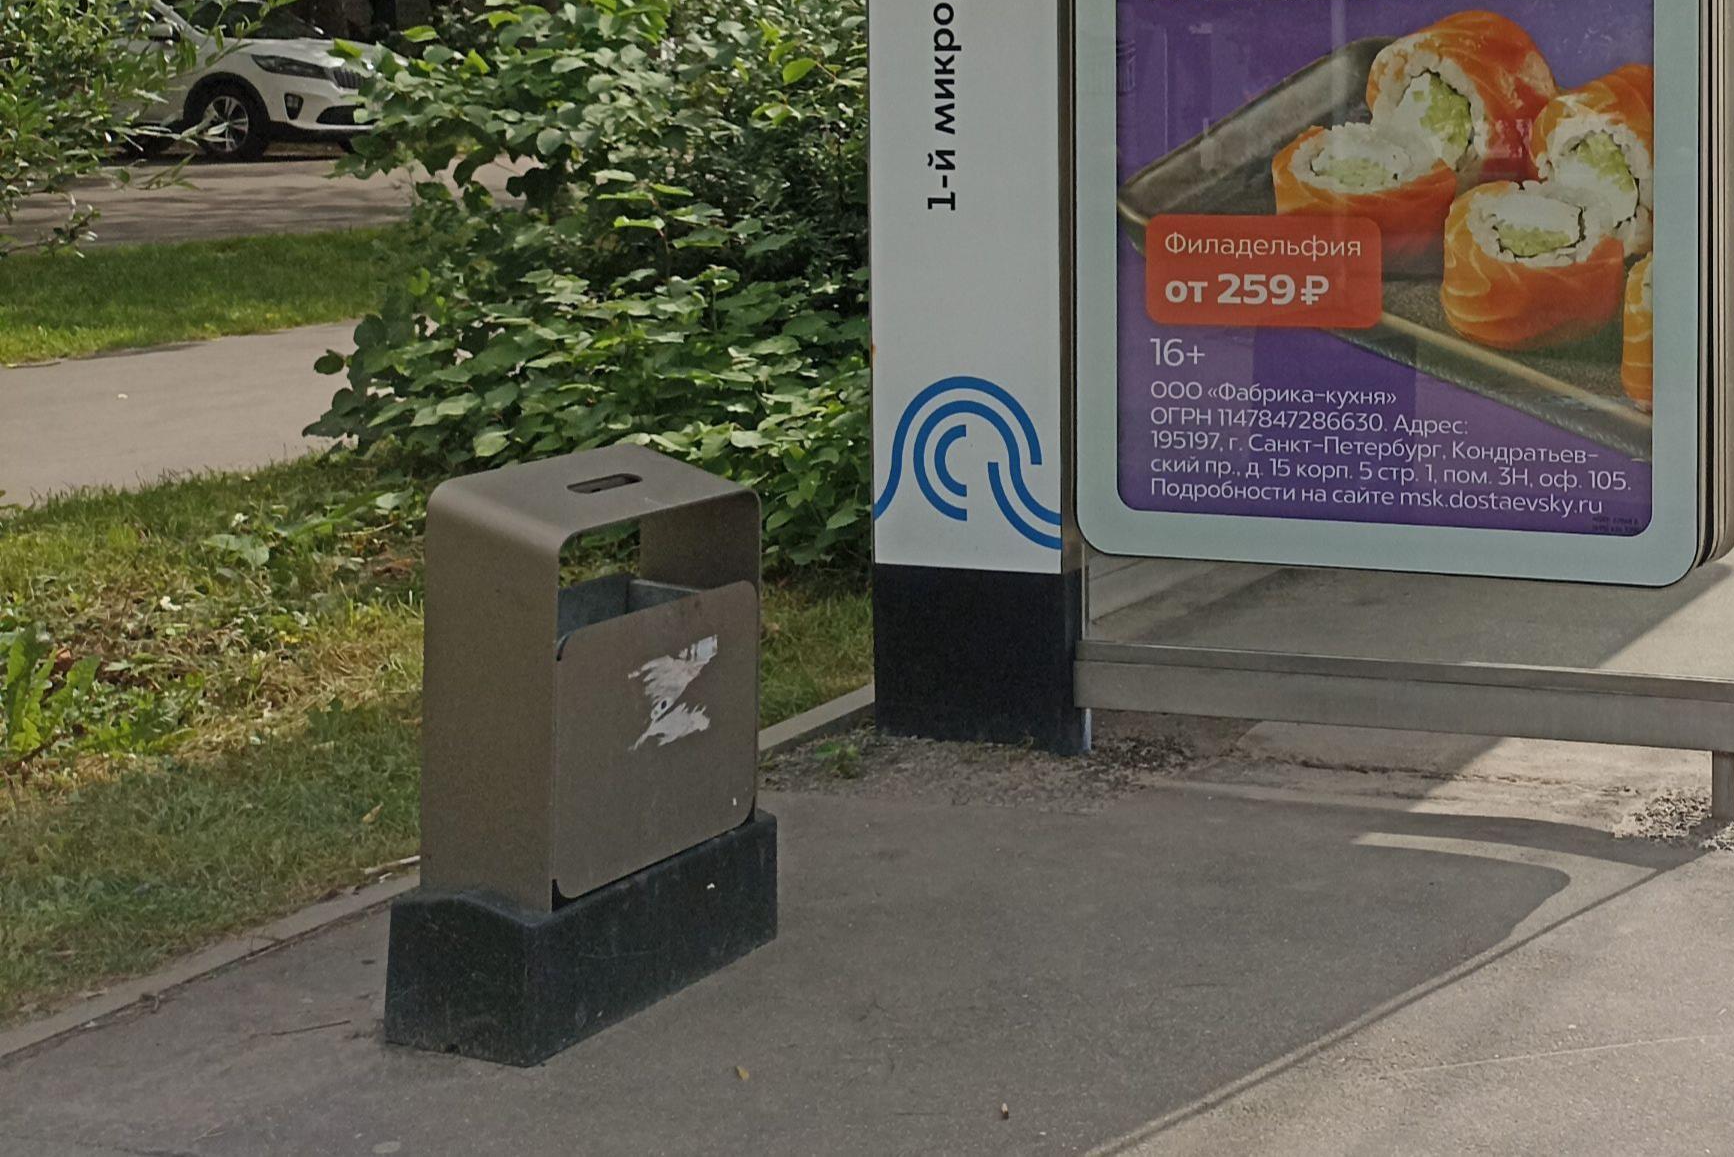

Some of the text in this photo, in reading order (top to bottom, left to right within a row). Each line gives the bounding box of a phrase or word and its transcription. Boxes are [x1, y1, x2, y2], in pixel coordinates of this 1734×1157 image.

[926, 149, 957, 212] 1-й
[1164, 232, 1361, 262] Филадельфия
[1164, 279, 1208, 304] от
[1149, 337, 1206, 367] 16+
[1150, 381, 1397, 409] ООО «Фабрика-кухня»
[1150, 406, 1469, 438] ОГРН 1147847286630. Адрес:
[1151, 430, 1600, 466] 195197, г. Санкт-Петербург, Кондратьев-
[1150, 456, 1632, 493] ский пр., д. 15 корп. 5 стр. 1, пом. 3Н, оф. 105.
[1150, 478, 1604, 519] Подробности на сайте msk.dostaevsky.ru
